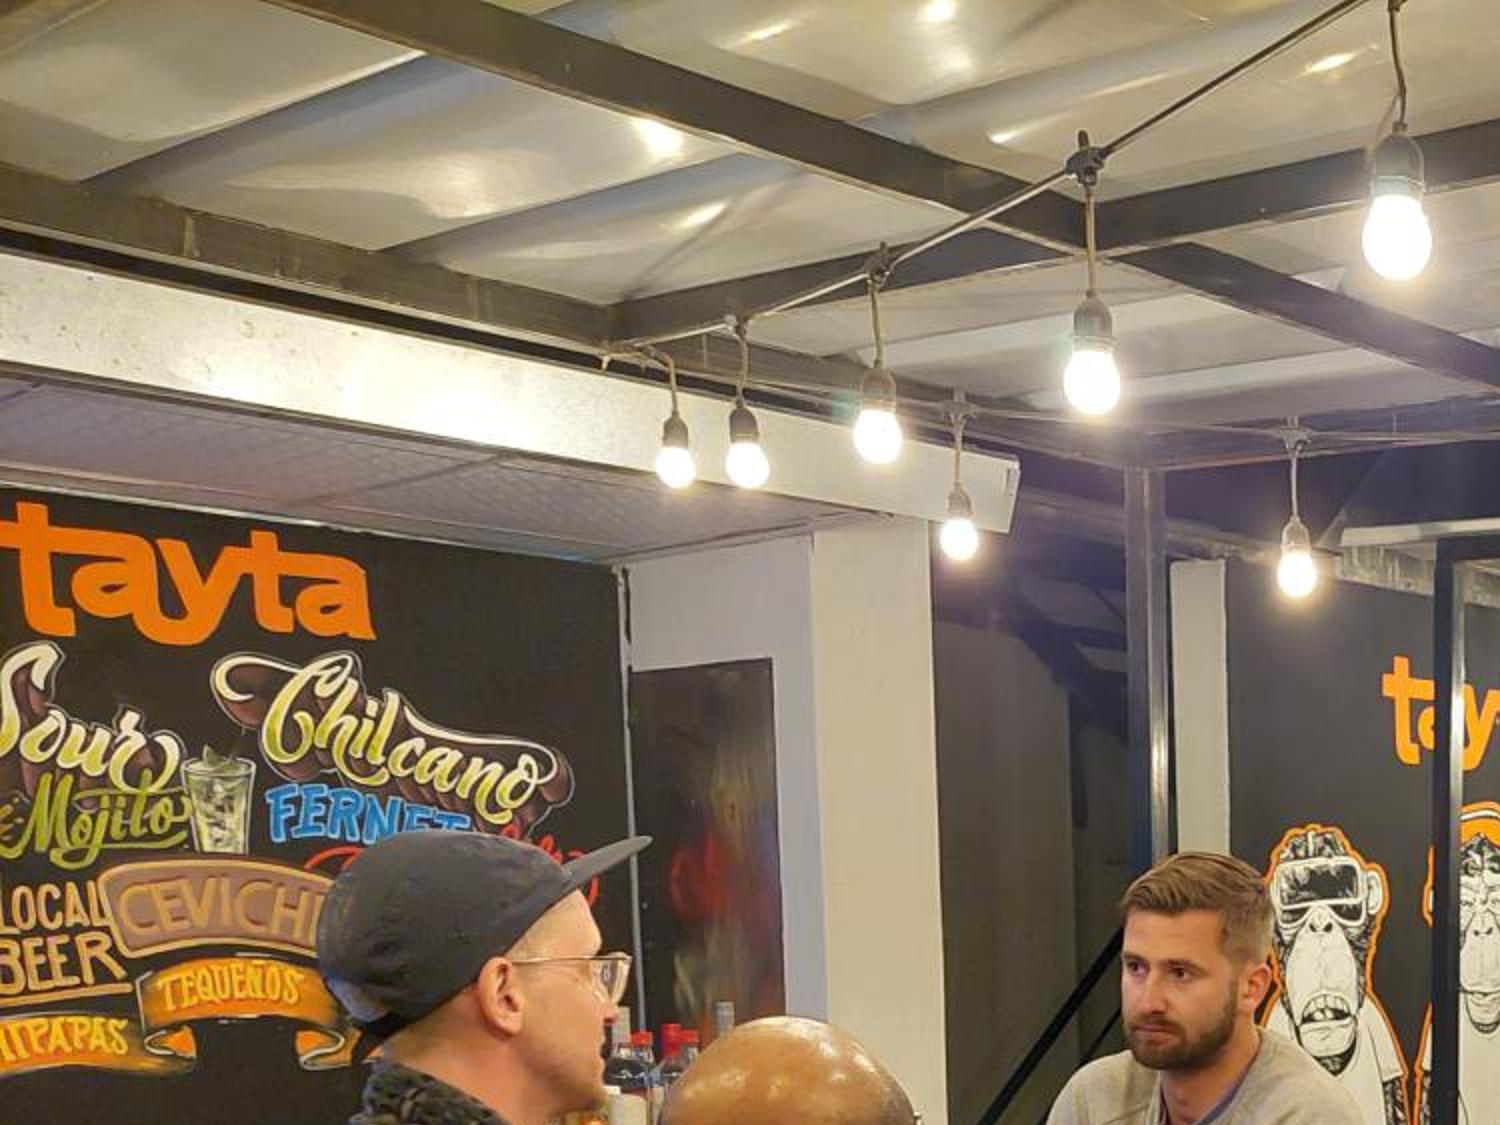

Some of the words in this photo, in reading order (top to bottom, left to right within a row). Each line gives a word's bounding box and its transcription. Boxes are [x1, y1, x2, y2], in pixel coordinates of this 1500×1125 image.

[0, 502, 377, 645] tayta
[214, 654, 557, 825] Chilcano
[0, 768, 193, 870] Mojito
[115, 874, 325, 946] CEVICH
